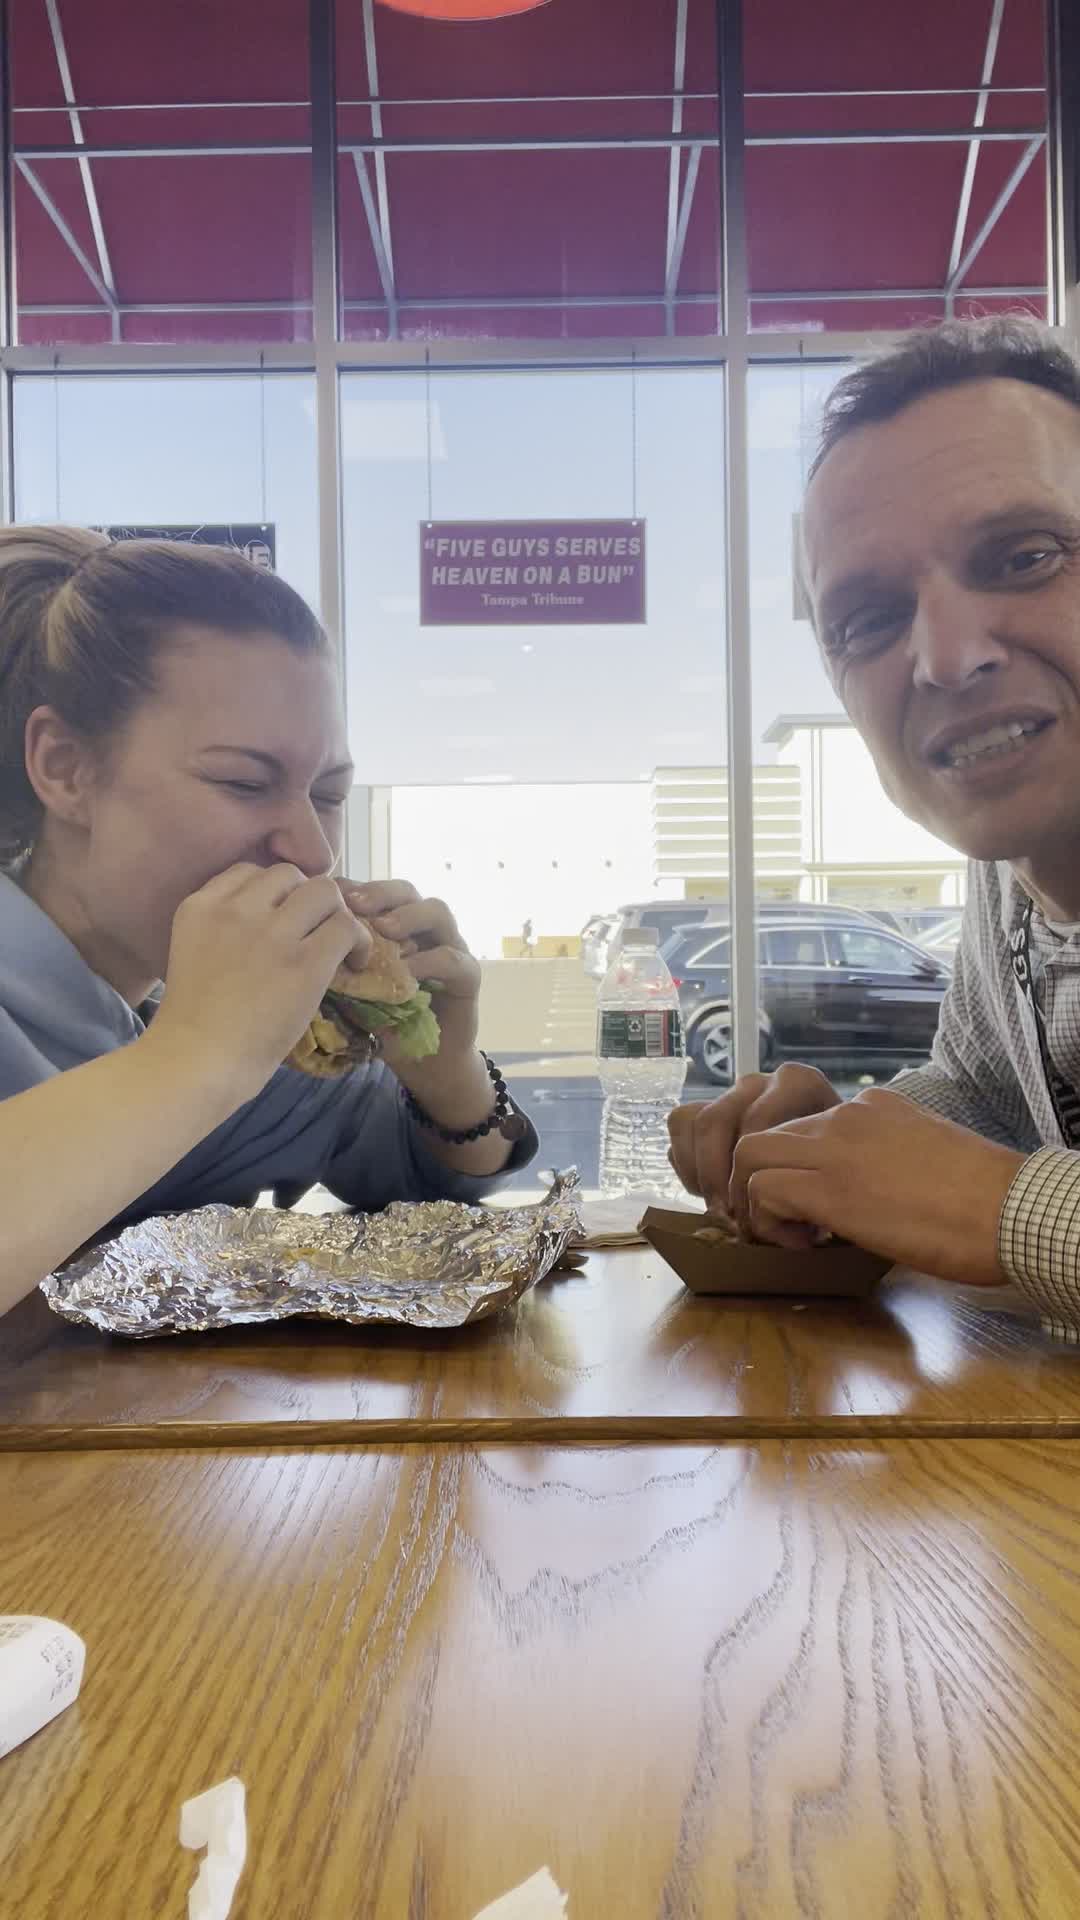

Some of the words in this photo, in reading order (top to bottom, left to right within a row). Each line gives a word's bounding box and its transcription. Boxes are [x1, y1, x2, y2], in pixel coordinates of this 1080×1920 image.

[423, 538, 486, 557] “FIVE
[491, 538, 549, 557] GUYS
[555, 536, 641, 556] SERVES
[431, 566, 518, 585] HEAVEN
[523, 566, 553, 585] ON
[557, 566, 571, 585] A
[576, 565, 635, 584] BUN”
[481, 593, 528, 607] Tampa
[531, 592, 585, 606] Tribune
